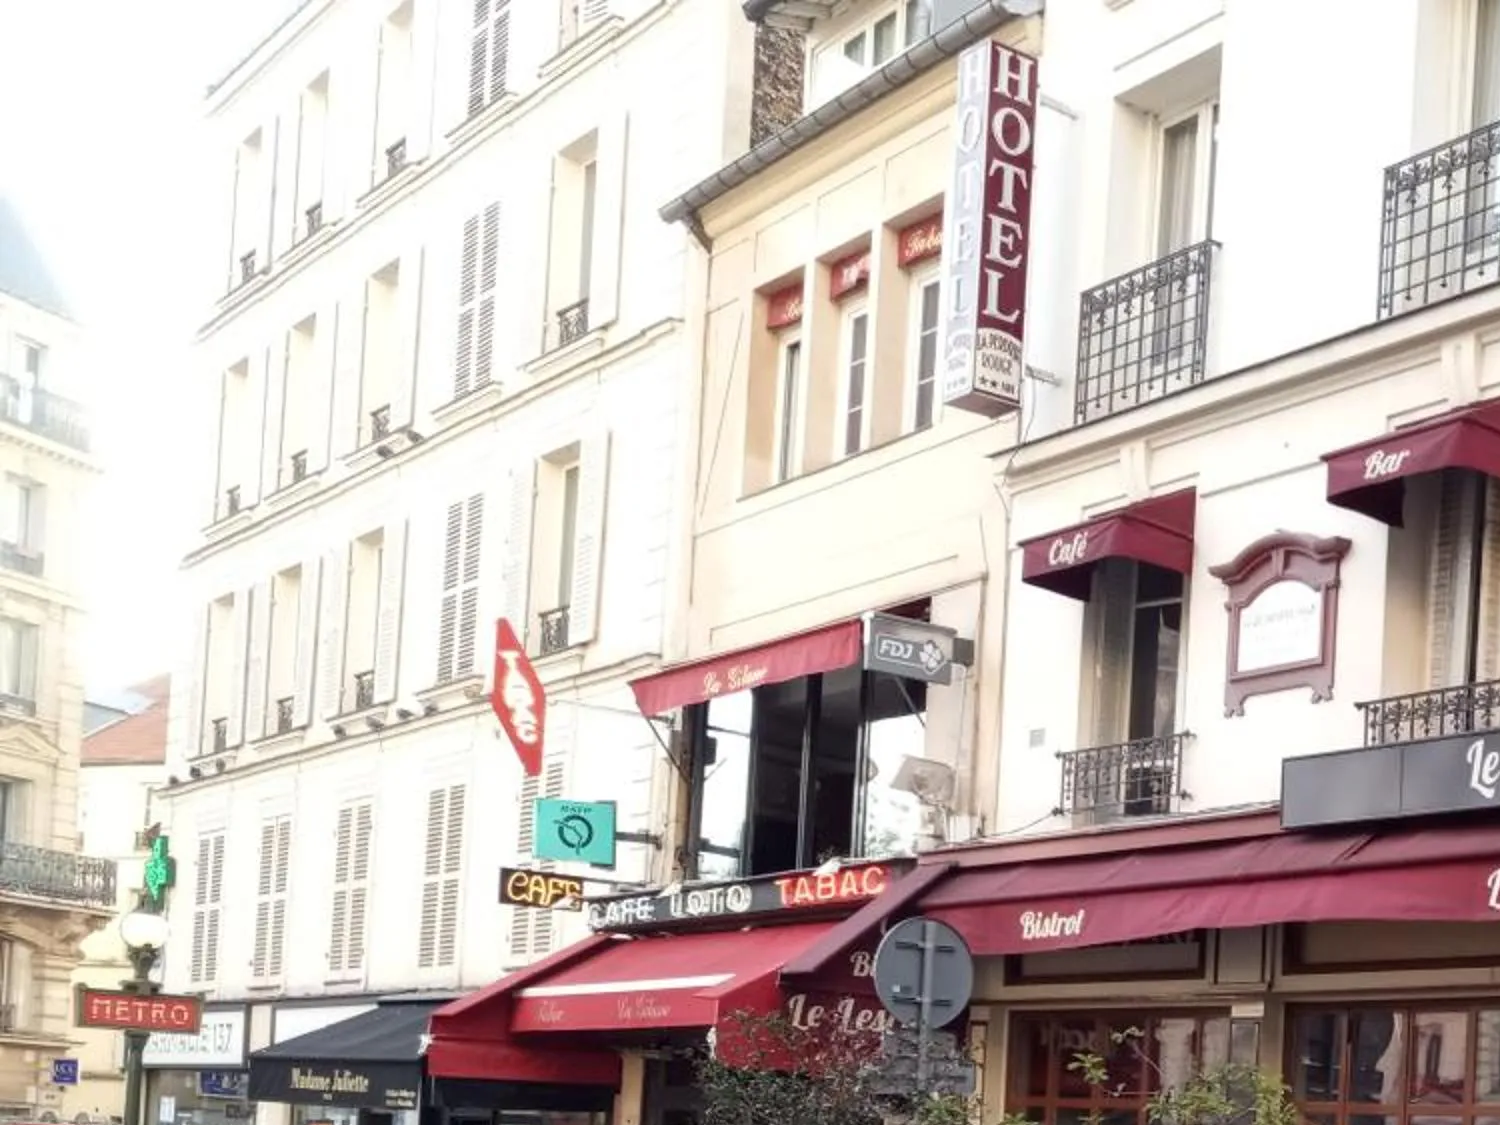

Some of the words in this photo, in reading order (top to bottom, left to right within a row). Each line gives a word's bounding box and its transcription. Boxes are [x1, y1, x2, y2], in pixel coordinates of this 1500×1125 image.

[981, 45, 1035, 325] HOTEL
[1363, 449, 1411, 480] Bar
[1048, 531, 1089, 566] Café
[879, 638, 914, 660] FDJ
[1466, 738, 1500, 800] Le
[669, 884, 754, 918] LOTO
[775, 865, 888, 907] TABAC
[1020, 909, 1085, 940] Bistrot
[91, 996, 190, 1026] METRO
[788, 993, 825, 1031] Le
